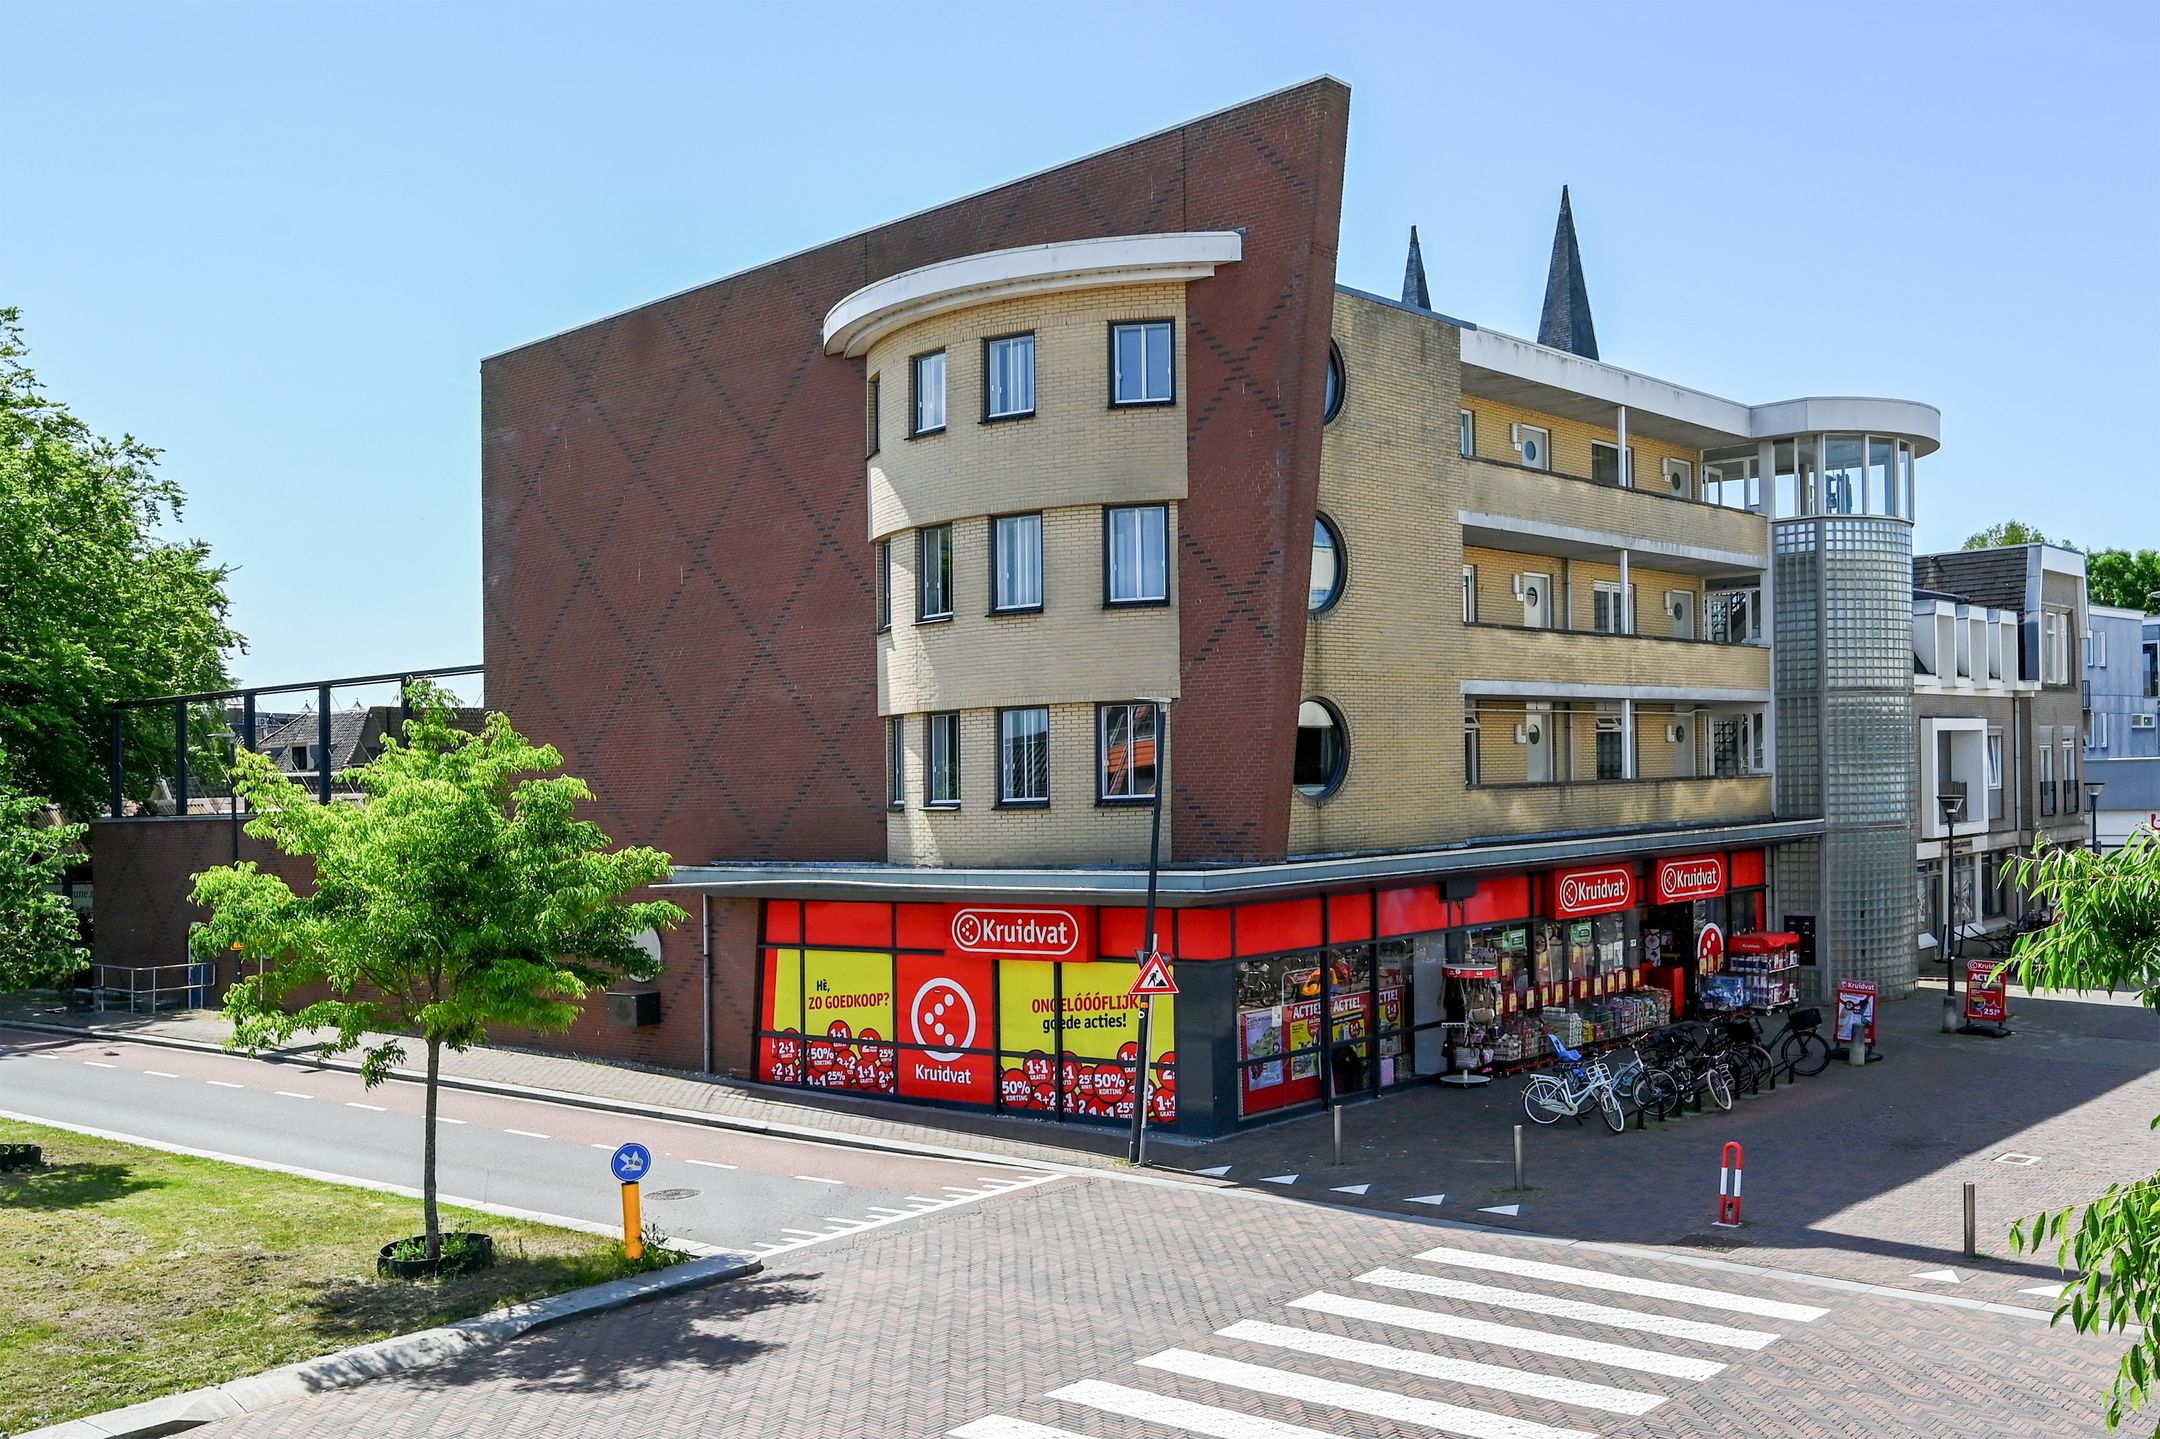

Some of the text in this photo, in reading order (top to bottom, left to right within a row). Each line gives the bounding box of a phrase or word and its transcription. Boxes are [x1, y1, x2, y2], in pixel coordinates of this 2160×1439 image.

[1677, 867, 1717, 888] Kruidvat
[1578, 879, 1625, 901] Kruidvat
[983, 918, 1068, 945] Kruidvat
[1847, 981, 1875, 991] Kruidvat
[808, 992, 890, 1010] ZO GOEDKOOP?
[1333, 996, 1360, 1013] ACTIE!
[1379, 989, 1398, 1004] CTIE!
[1084, 1012, 1127, 1029] acties!
[778, 1041, 795, 1054] 2+1
[810, 1047, 834, 1060] 50%
[827, 1071, 846, 1081] 25%
[857, 1065, 876, 1079] 1+1
[915, 1063, 972, 1085] Kruidvat
[1027, 1059, 1048, 1076] 1+1
[1002, 1080, 1031, 1095] 50%
[1094, 1073, 1125, 1090] 50%
